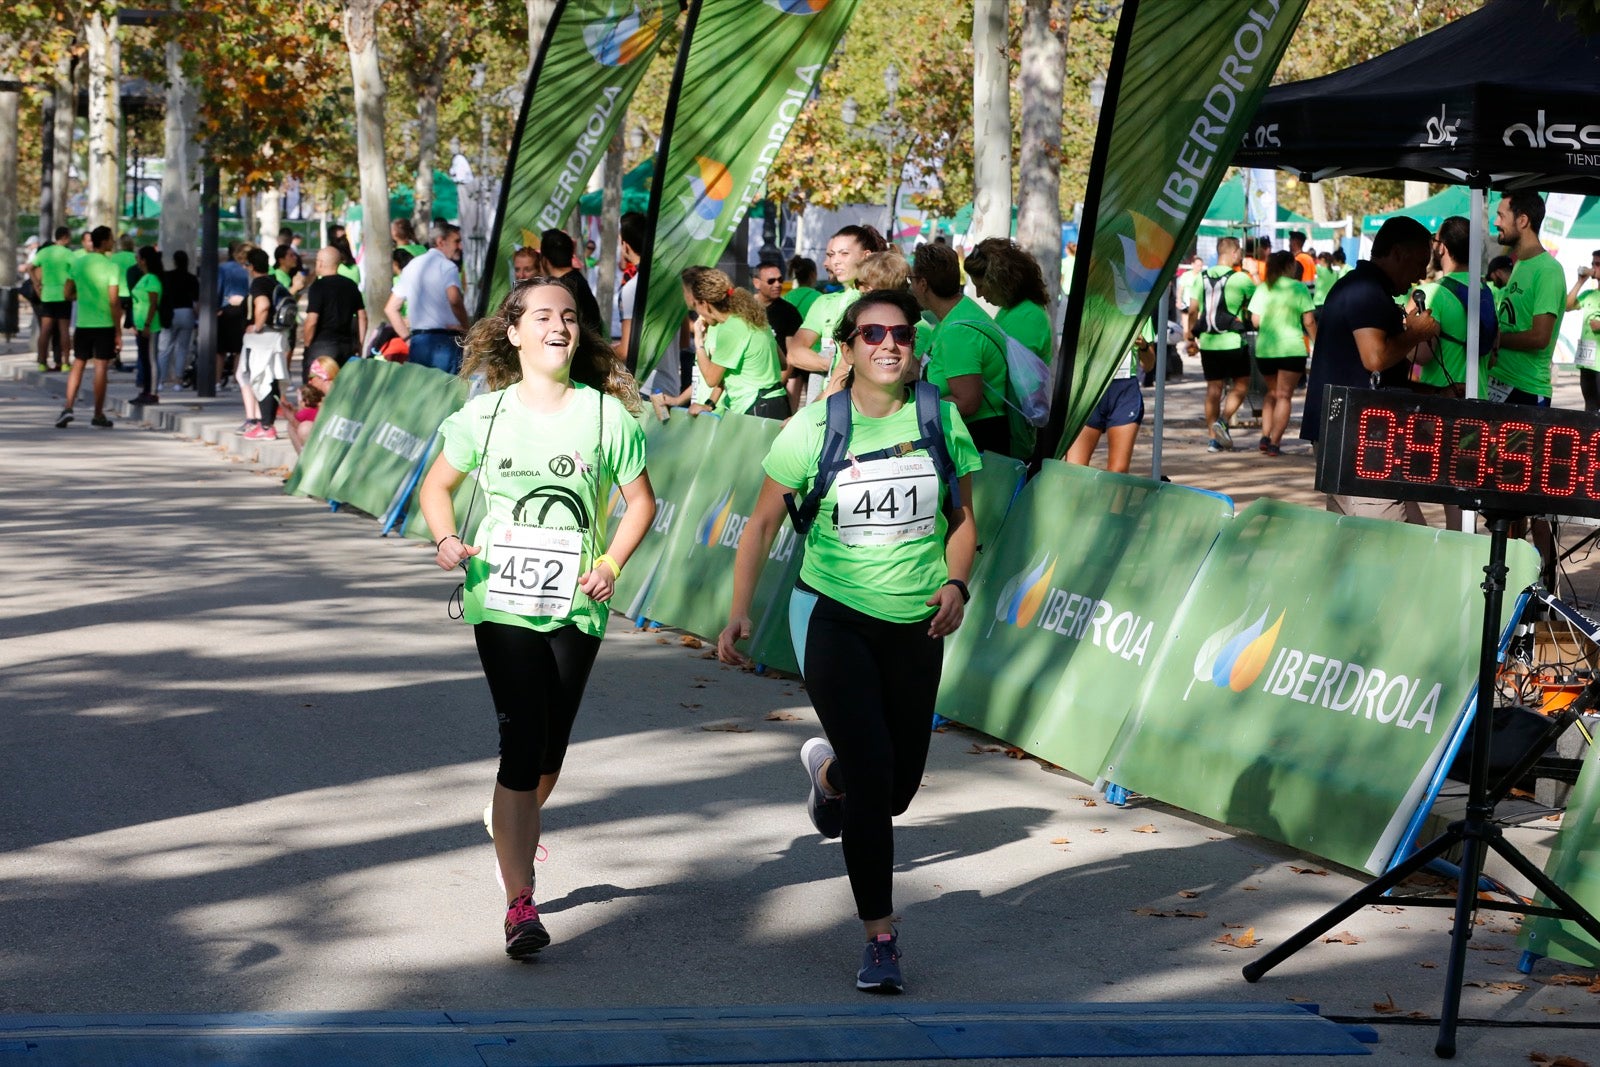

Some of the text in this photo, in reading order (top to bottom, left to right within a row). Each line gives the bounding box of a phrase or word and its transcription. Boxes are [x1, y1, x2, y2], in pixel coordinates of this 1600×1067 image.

[536, 86, 623, 232] IBERDROLA
[500, 469, 541, 478] IBERDROLA
[852, 485, 918, 519] 441
[500, 555, 564, 591] 452
[1263, 647, 1443, 734] IBERDROLA
